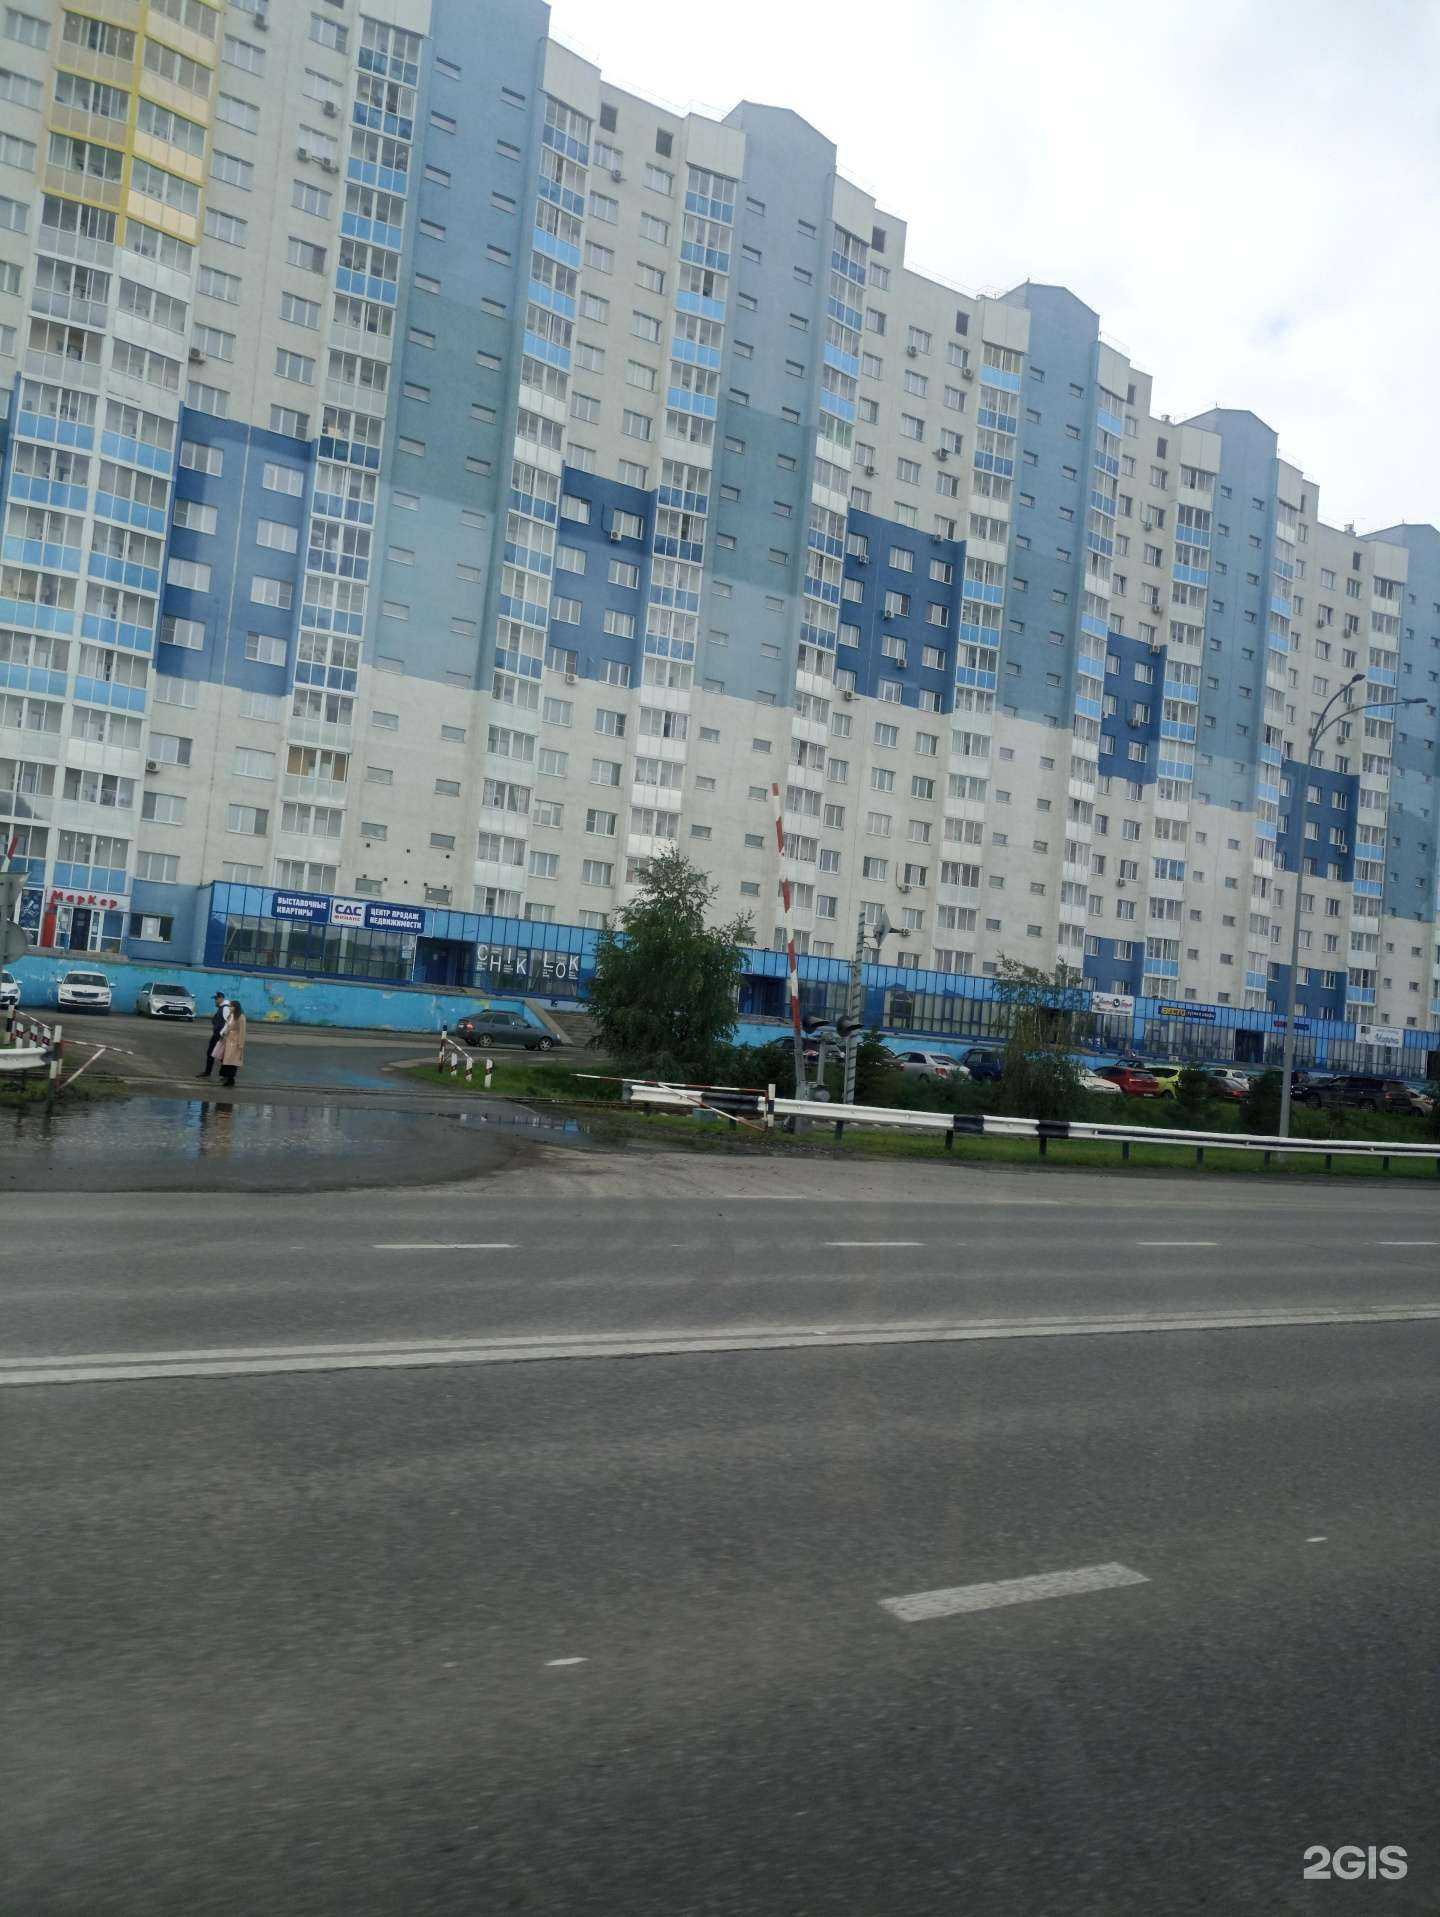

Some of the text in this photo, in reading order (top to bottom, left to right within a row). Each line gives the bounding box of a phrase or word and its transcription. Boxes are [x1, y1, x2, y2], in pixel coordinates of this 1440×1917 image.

[277, 896, 327, 910] ВЫСТАВОЧНЫЕ
[276, 906, 313, 917] КВАРТИРЫ
[370, 908, 420, 921] ЦЕНТР ПРОДАЖ
[369, 916, 422, 929] НЕДВИЖИМОСТИ
